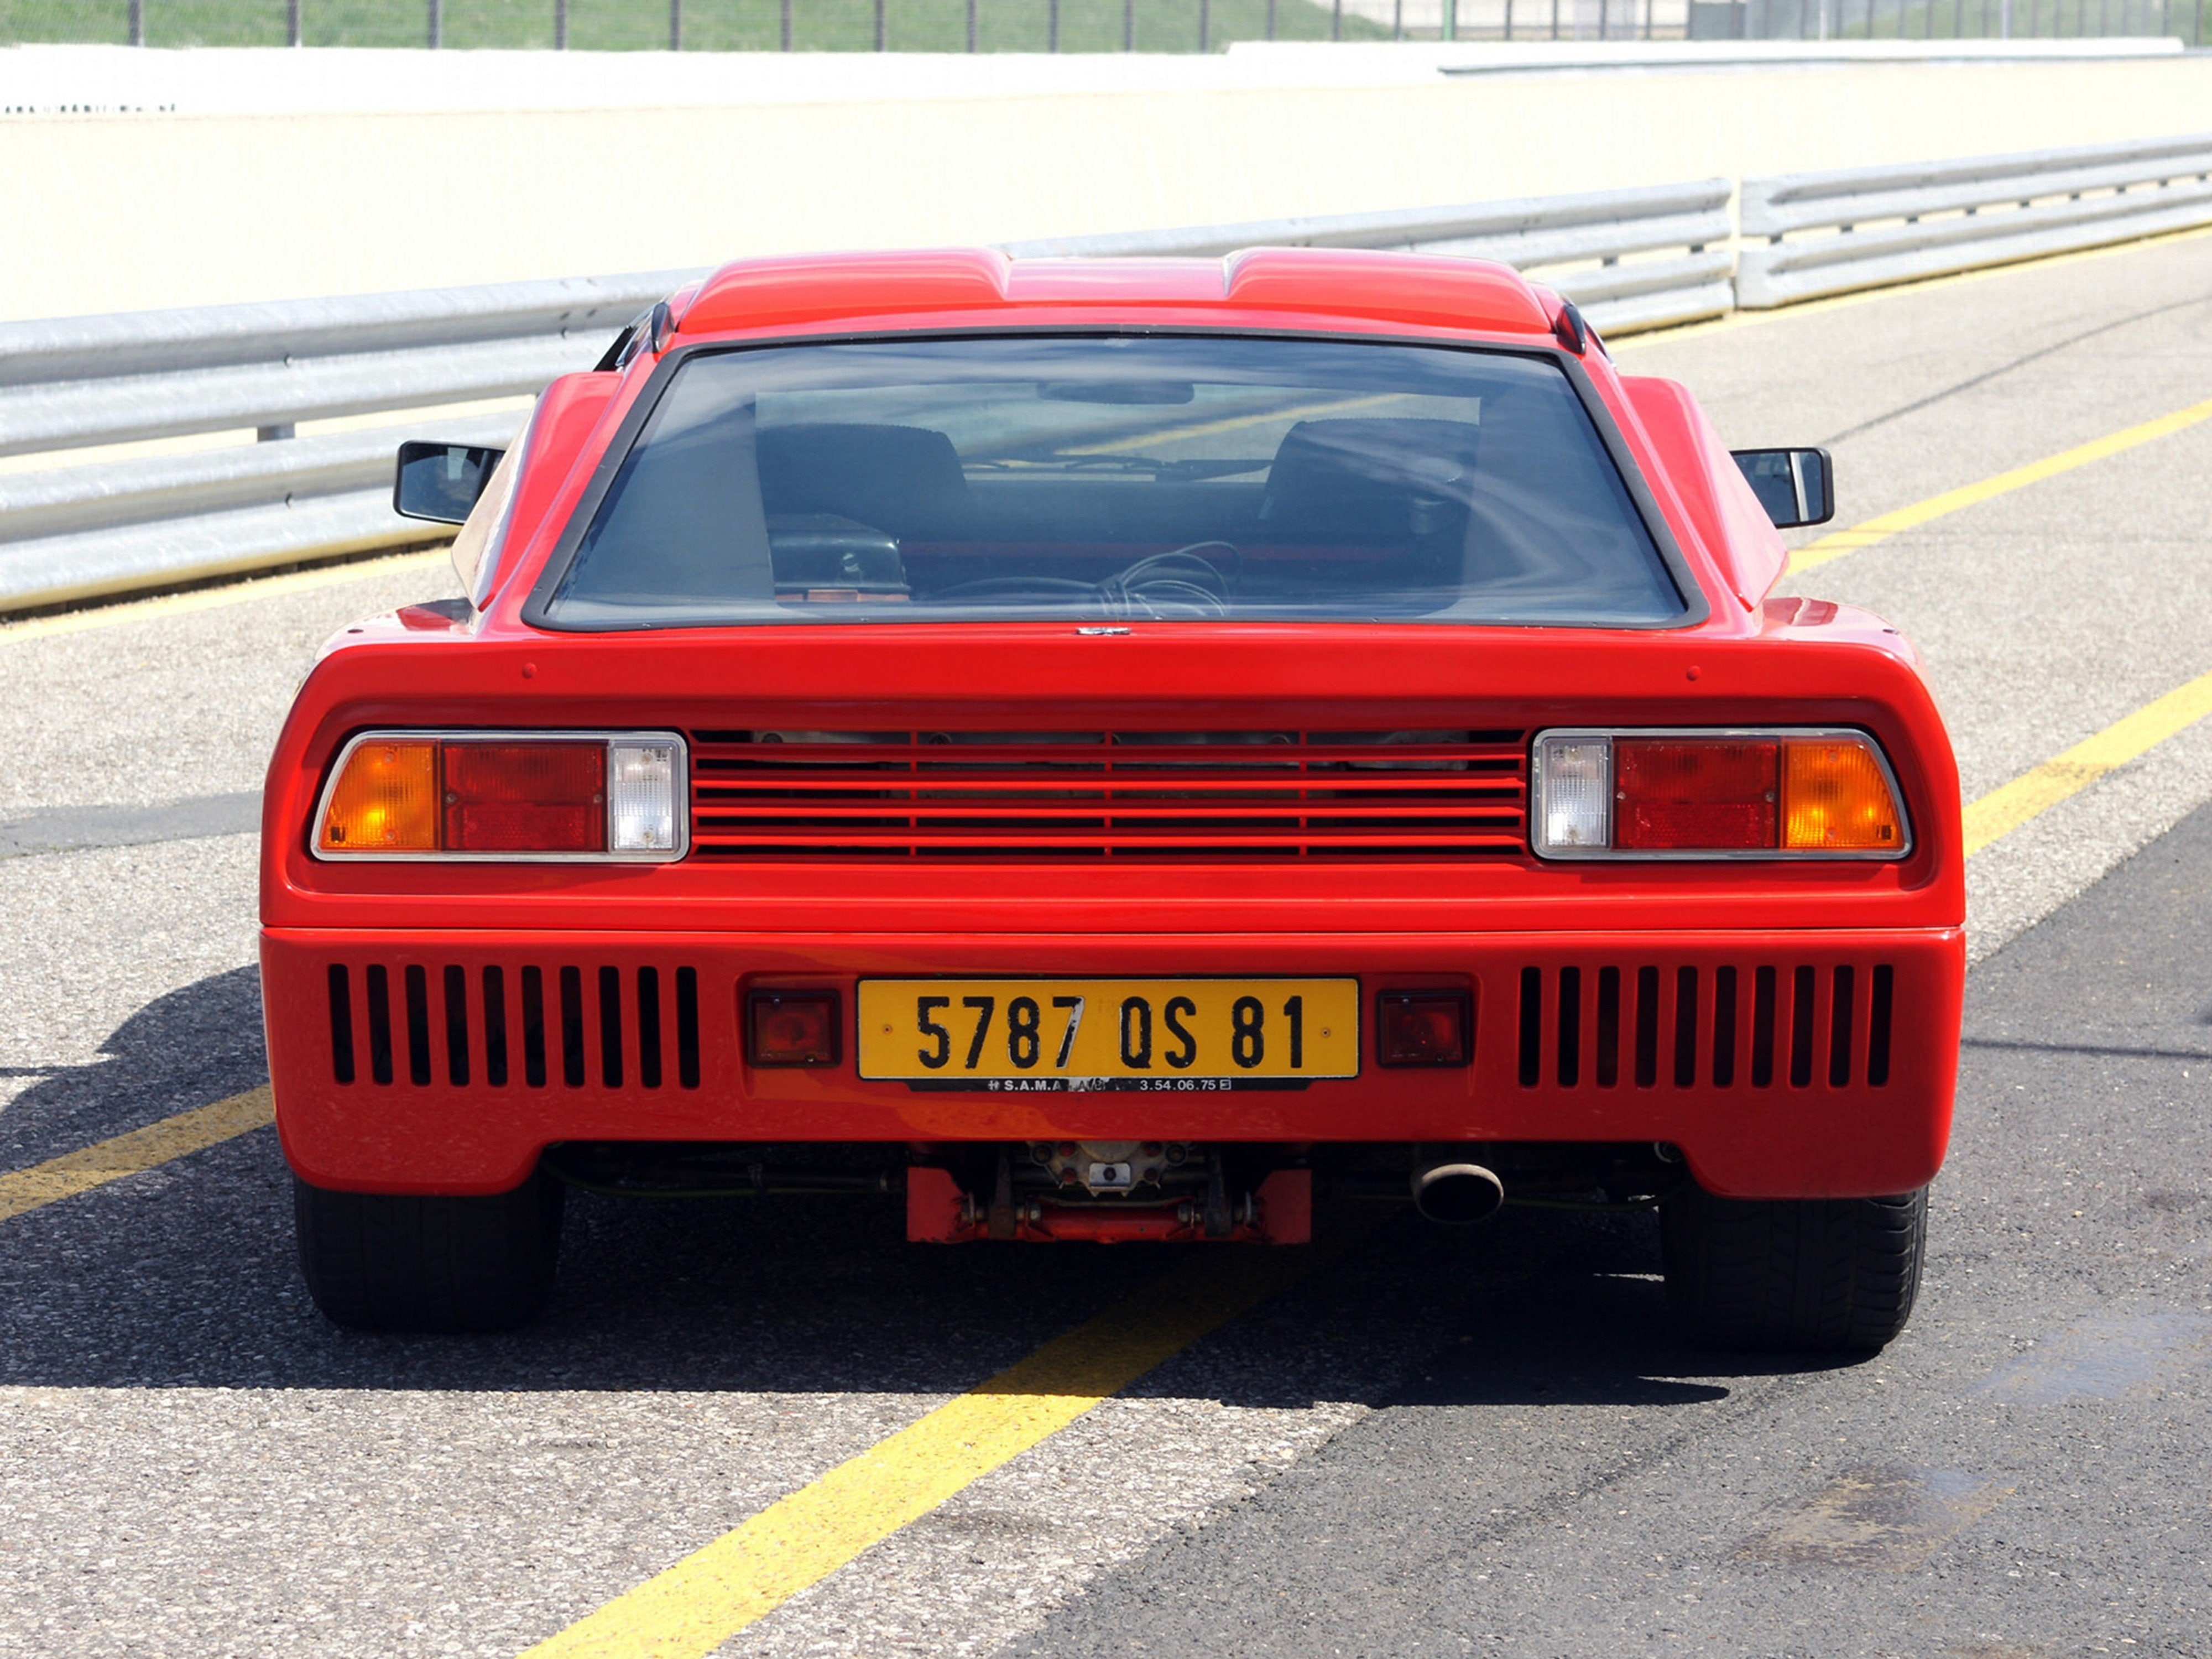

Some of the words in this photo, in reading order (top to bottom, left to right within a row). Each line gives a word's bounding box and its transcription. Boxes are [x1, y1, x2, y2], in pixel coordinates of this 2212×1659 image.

[917, 996, 1084, 1068] 5787
[1120, 996, 1196, 1068] QS
[1232, 995, 1302, 1068] 81
